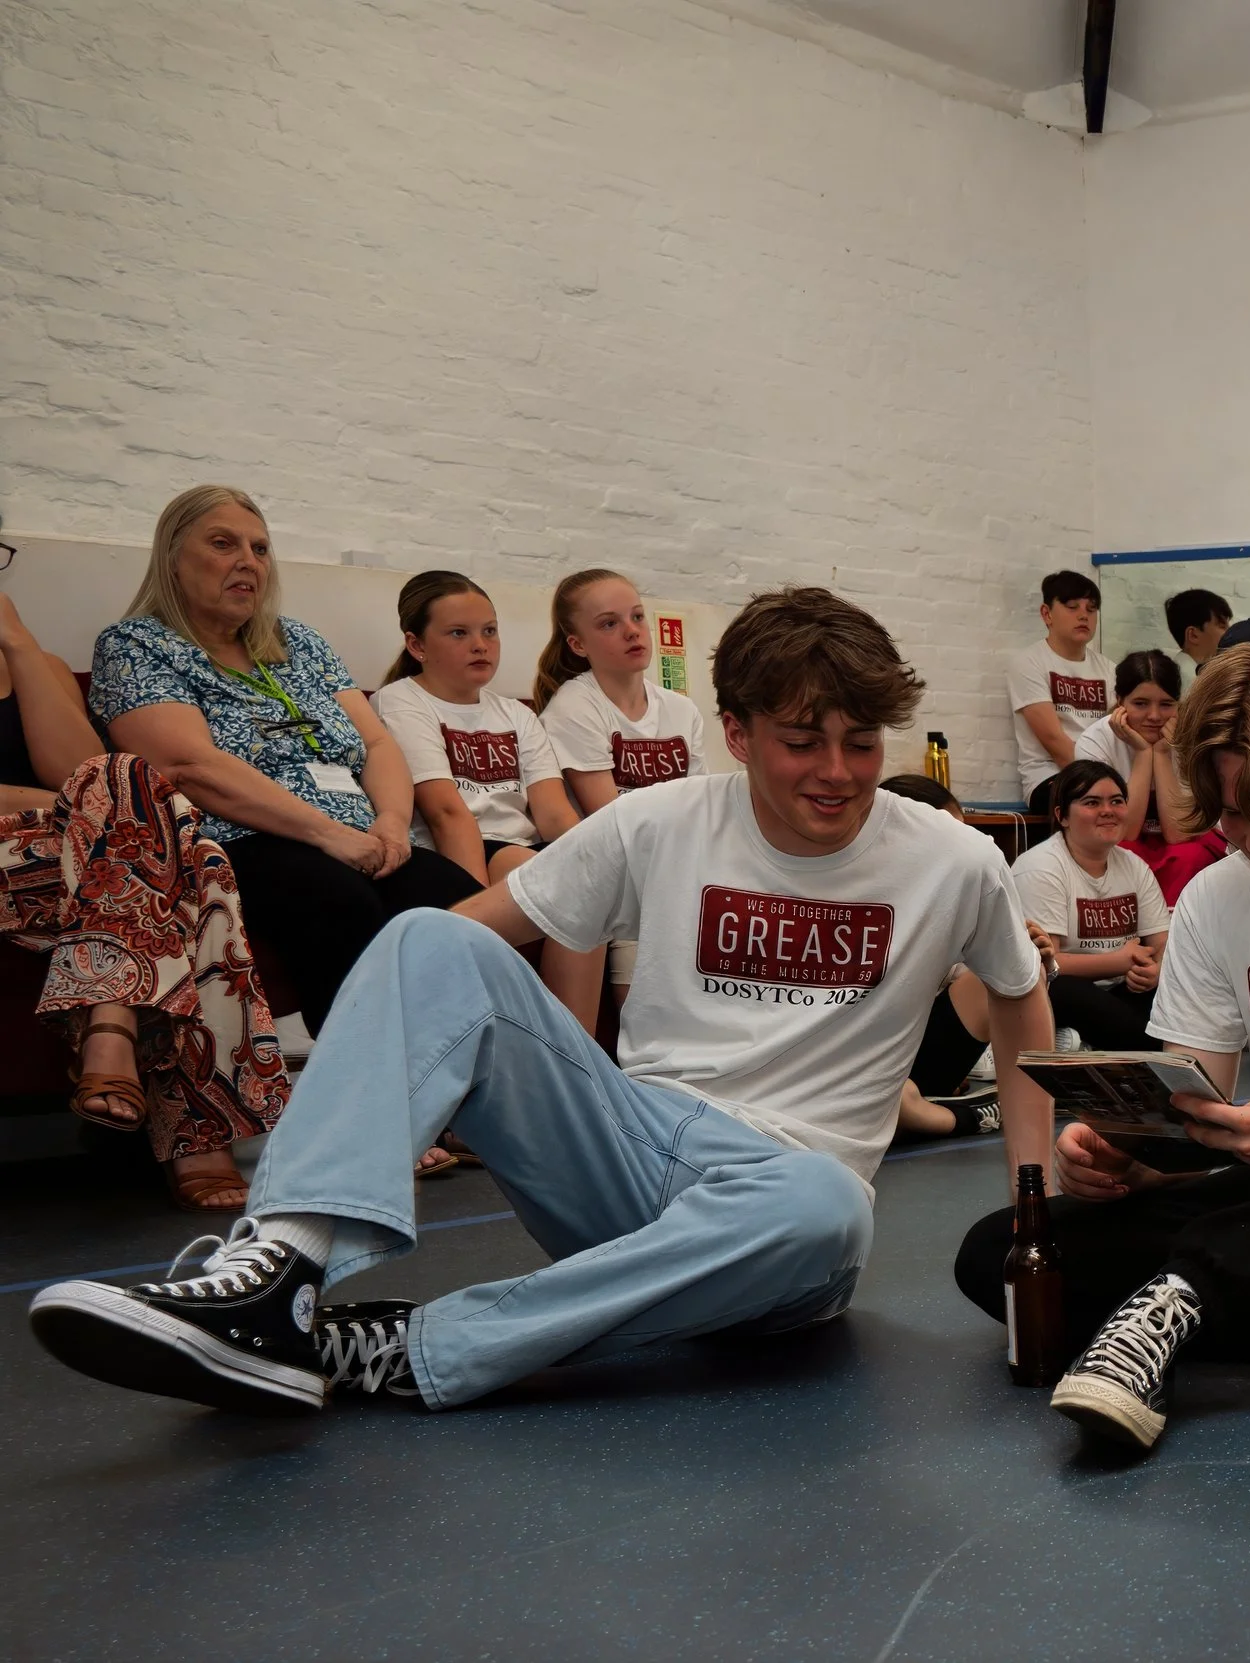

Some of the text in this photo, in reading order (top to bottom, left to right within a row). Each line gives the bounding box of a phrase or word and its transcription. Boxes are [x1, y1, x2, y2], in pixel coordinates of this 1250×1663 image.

[1056, 680, 1104, 703] GREASE
[748, 899, 852, 920] WE GO TOGETHER
[1084, 904, 1136, 928] GREASE
[718, 912, 879, 965] GREASE
[719, 960, 730, 970] 19
[741, 962, 767, 976] THE
[779, 966, 845, 982] MUSICAL
[702, 977, 814, 1006] DOSYTCo
